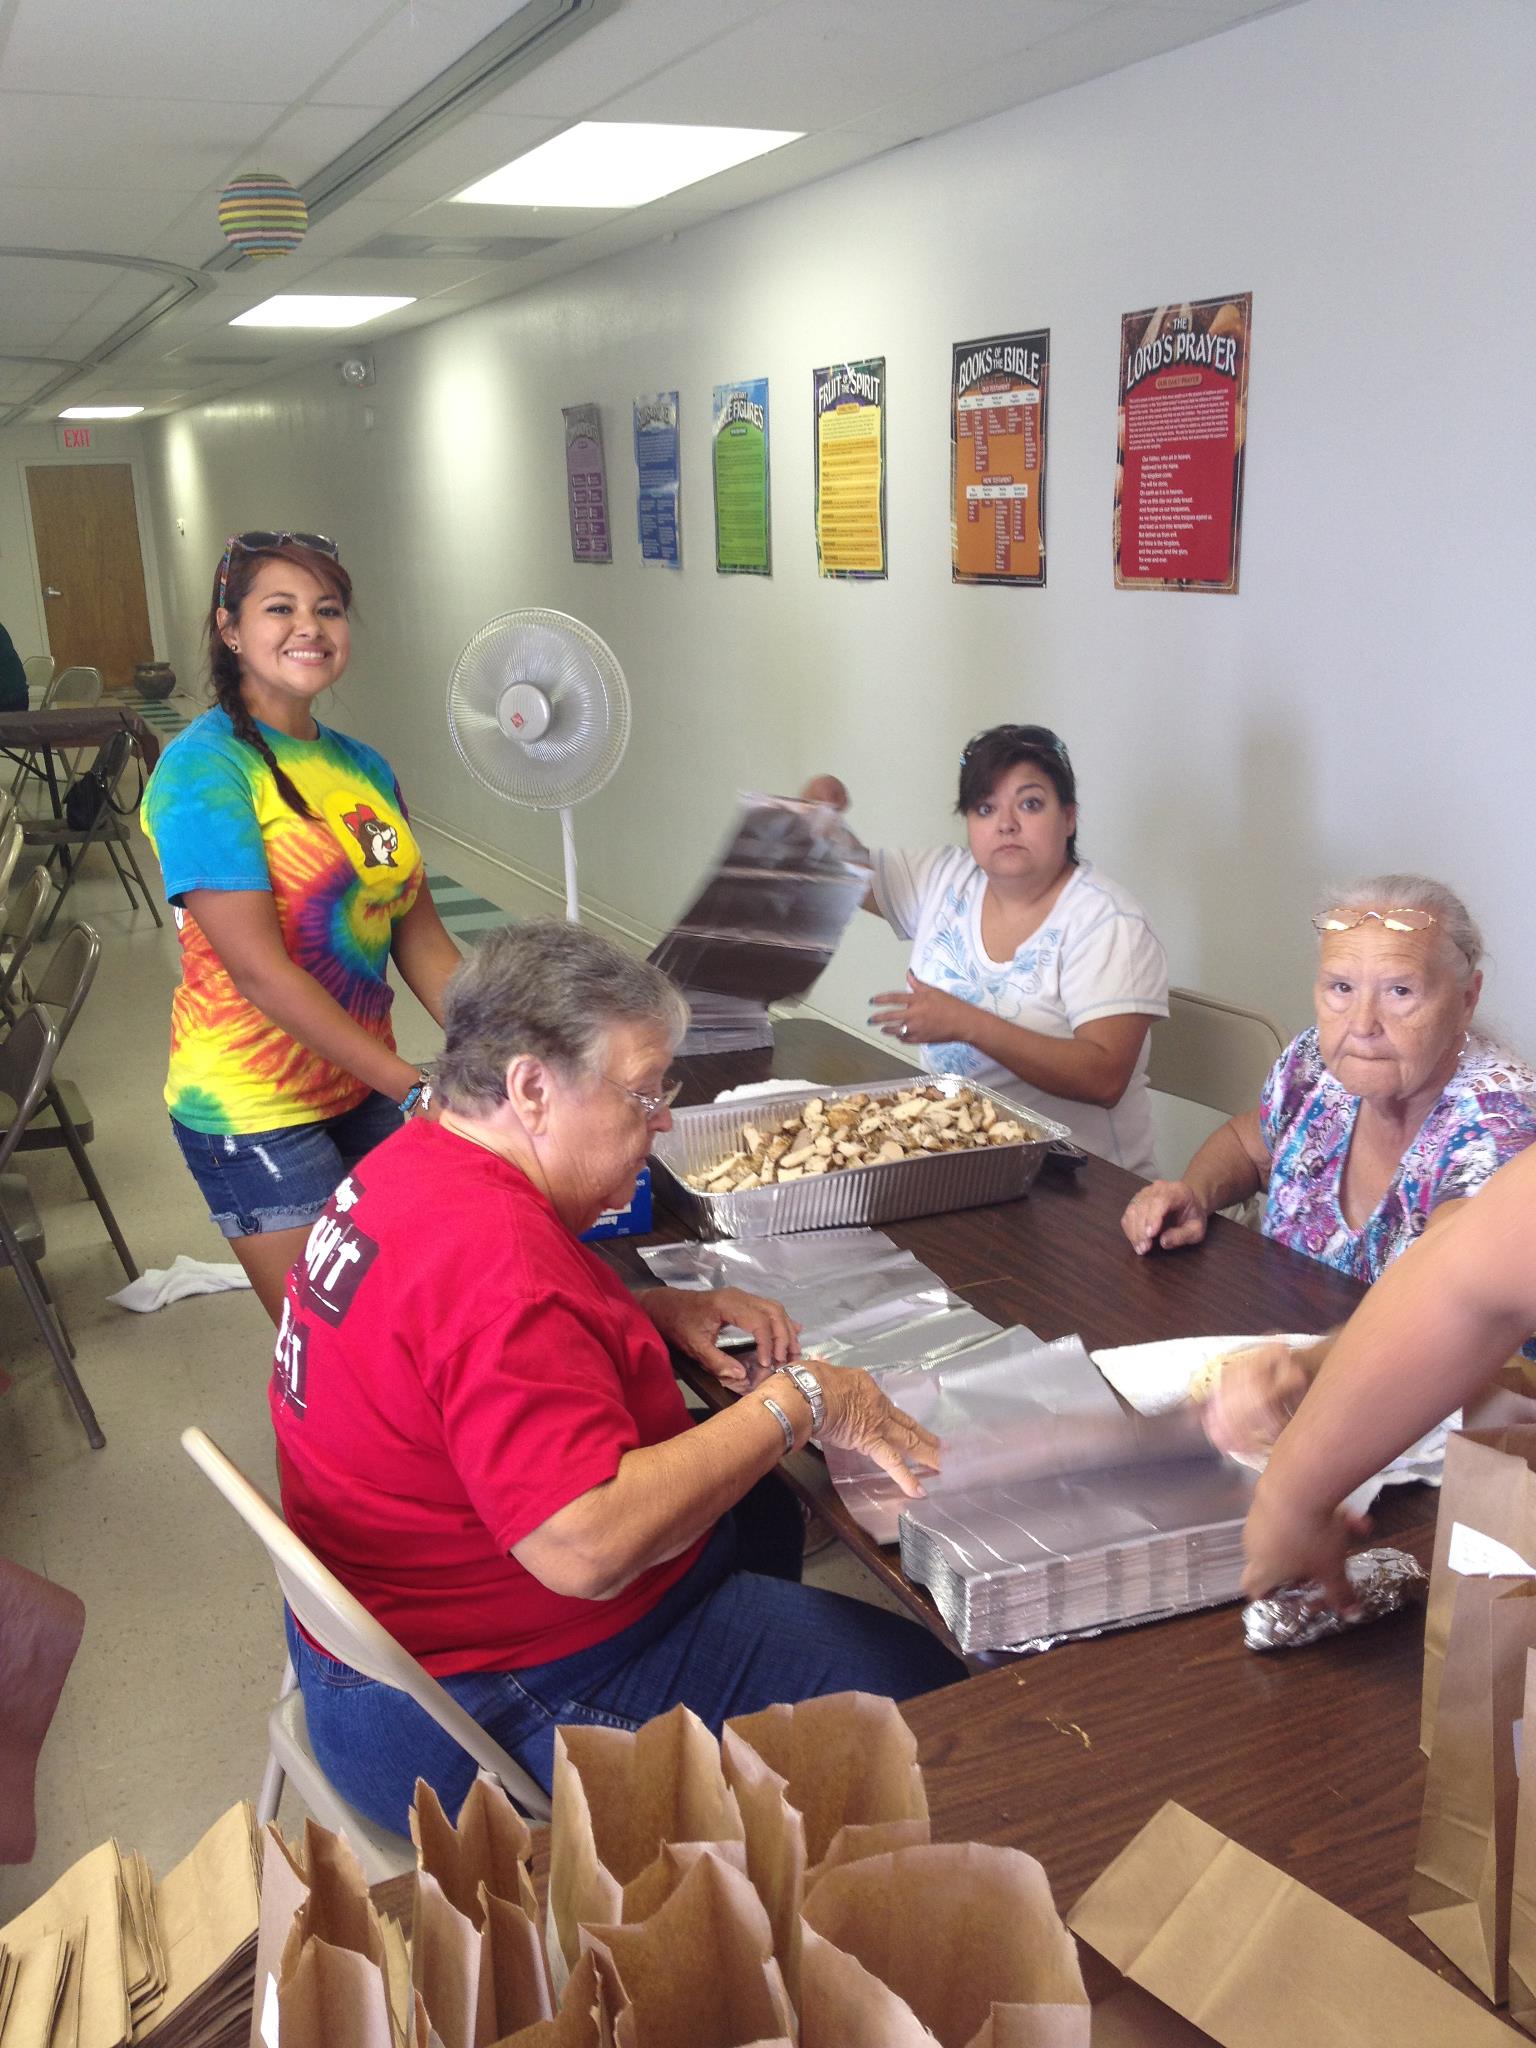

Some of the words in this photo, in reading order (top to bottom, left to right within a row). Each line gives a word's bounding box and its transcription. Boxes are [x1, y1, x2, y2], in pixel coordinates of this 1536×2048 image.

[1173, 318, 1187, 331] THE
[959, 347, 992, 395] BOOKS
[993, 358, 1003, 369] THE
[1004, 346, 1039, 386] BIBLE
[1127, 333, 1173, 389] LORD'S
[1176, 332, 1236, 376] PRAYER
[819, 376, 841, 414] FRUIT
[850, 372, 880, 405] SPIRIT
[734, 400, 763, 430] FIGURES
[64, 429, 91, 448] EXIT
